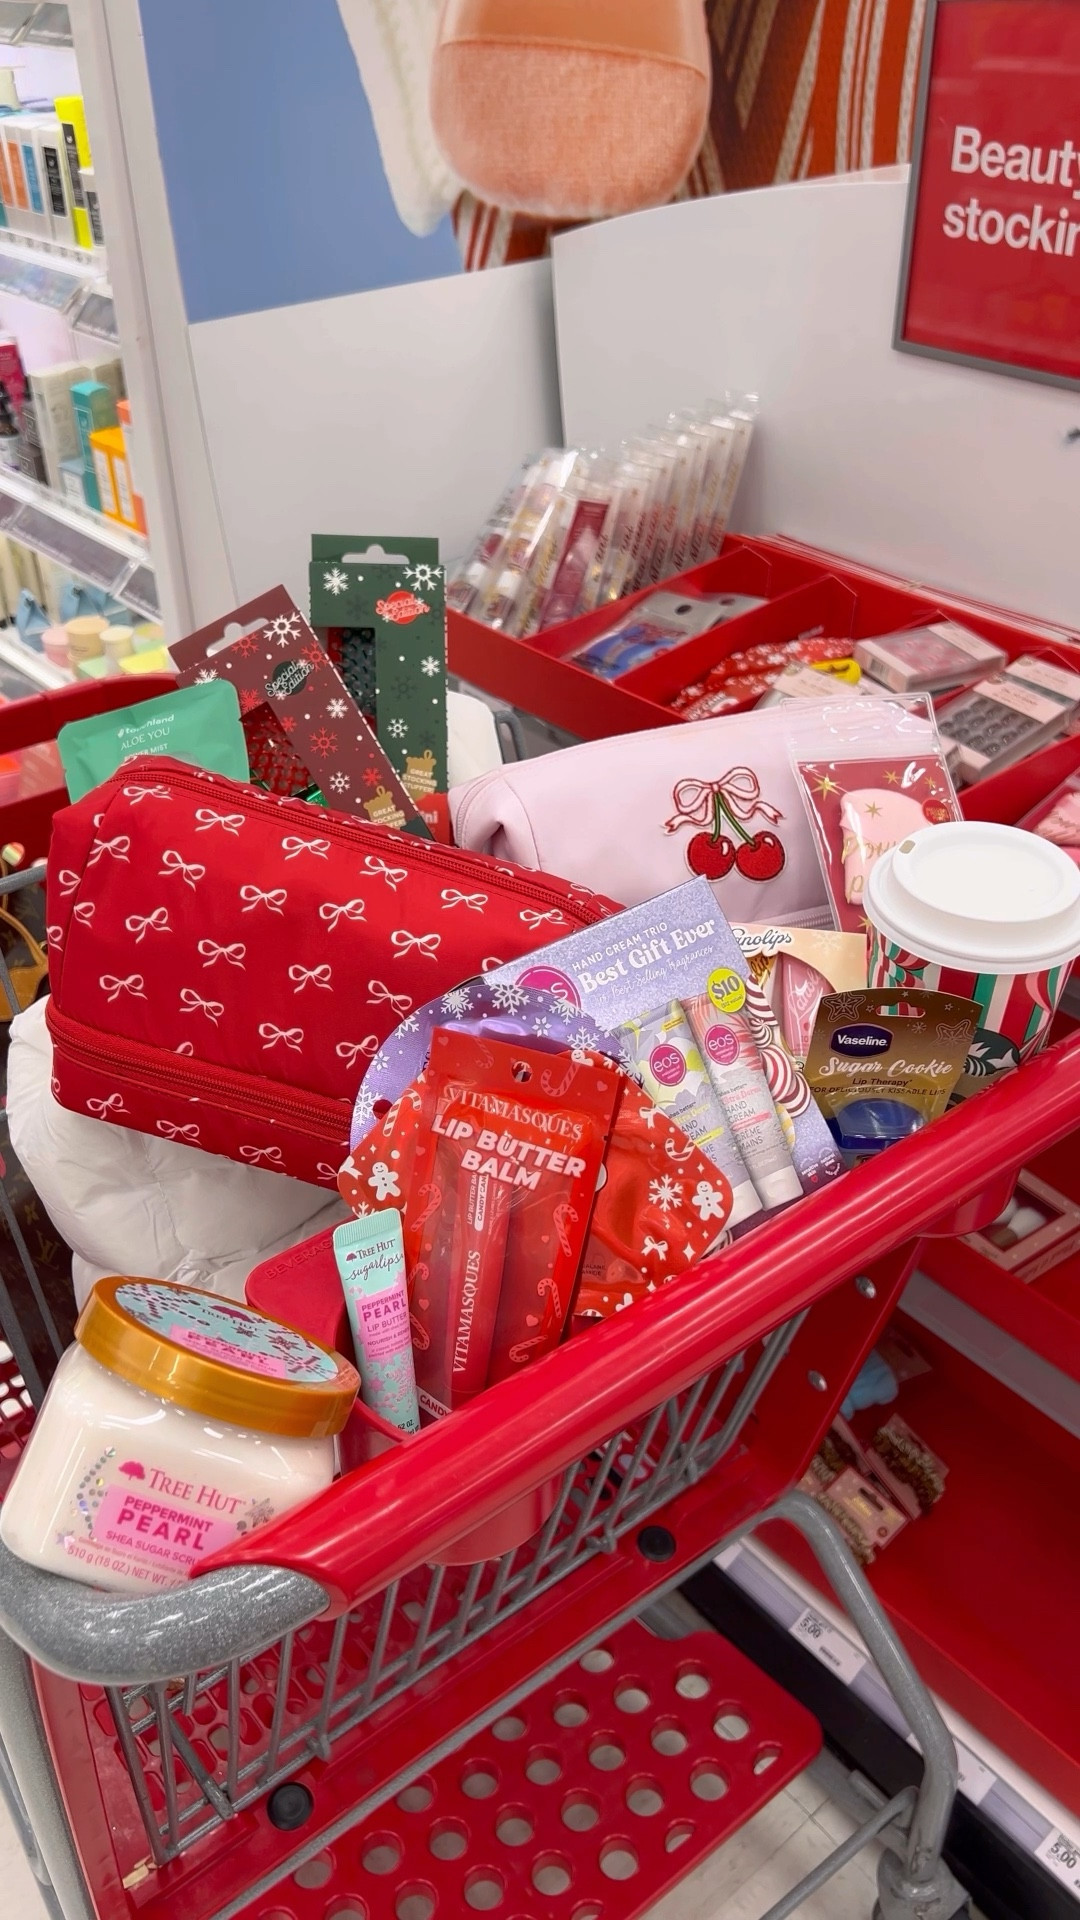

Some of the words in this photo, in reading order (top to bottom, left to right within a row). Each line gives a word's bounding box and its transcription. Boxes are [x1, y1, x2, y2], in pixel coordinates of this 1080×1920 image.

[265, 661, 299, 697] Special
[280, 662, 314, 695] Edition
[120, 734, 146, 751] ALOE
[148, 727, 170, 740] YOU
[150, 743, 168, 754] MIST
[402, 773, 437, 788] STOCKING
[410, 768, 433, 780] GREAT
[372, 804, 396, 817] GREAT
[572, 951, 604, 972] HAND
[605, 933, 642, 957] CREAM
[643, 921, 668, 939] TRIO
[577, 958, 629, 994] Best
[628, 936, 672, 969] Gift
[670, 919, 716, 951] Ever
[711, 975, 740, 1002] $10
[708, 1034, 735, 1051] eos
[837, 1033, 887, 1047] Vaseline
[653, 1052, 680, 1073] eos
[819, 1057, 883, 1077] Sugar
[887, 1059, 953, 1077] Cookie
[852, 1077, 868, 1085] Lip
[887, 1087, 927, 1095] KISSABLE
[448, 1087, 583, 1140] VITAMASQUES
[725, 1101, 748, 1114] HAND
[728, 1109, 756, 1123] CREAM
[681, 1120, 698, 1133] AND
[690, 1126, 708, 1140] EAM
[431, 1115, 473, 1140] LIP
[476, 1130, 586, 1178] BUTTER
[739, 1137, 764, 1151] MAINS
[461, 1150, 541, 1190] BALM
[477, 1194, 485, 1222] CANDY
[264, 1240, 332, 1279] BEVERAG
[356, 1247, 376, 1259] TREE
[376, 1239, 396, 1252] HUT
[345, 1254, 403, 1281] sugarlips
[361, 1290, 404, 1311] PEPPERMINT
[363, 1298, 407, 1322] PEARL
[453, 1250, 481, 1373] VITAMASQUES
[367, 1324, 380, 1333] LIP
[381, 1312, 407, 1328] BUTTER
[148, 1468, 194, 1500] TREE
[194, 1484, 243, 1515] HUT
[124, 1495, 213, 1532] PEPPERMINT
[117, 1508, 205, 1550] PEARL
[106, 1530, 134, 1546] SHEA
[134, 1540, 171, 1559] SUGAR
[67, 1545, 87, 1559] 510
[86, 1553, 94, 1564] g
[94, 1555, 111, 1568] (18
[131, 1566, 152, 1580] NET
[1050, 1842, 1077, 1869] 5.00
